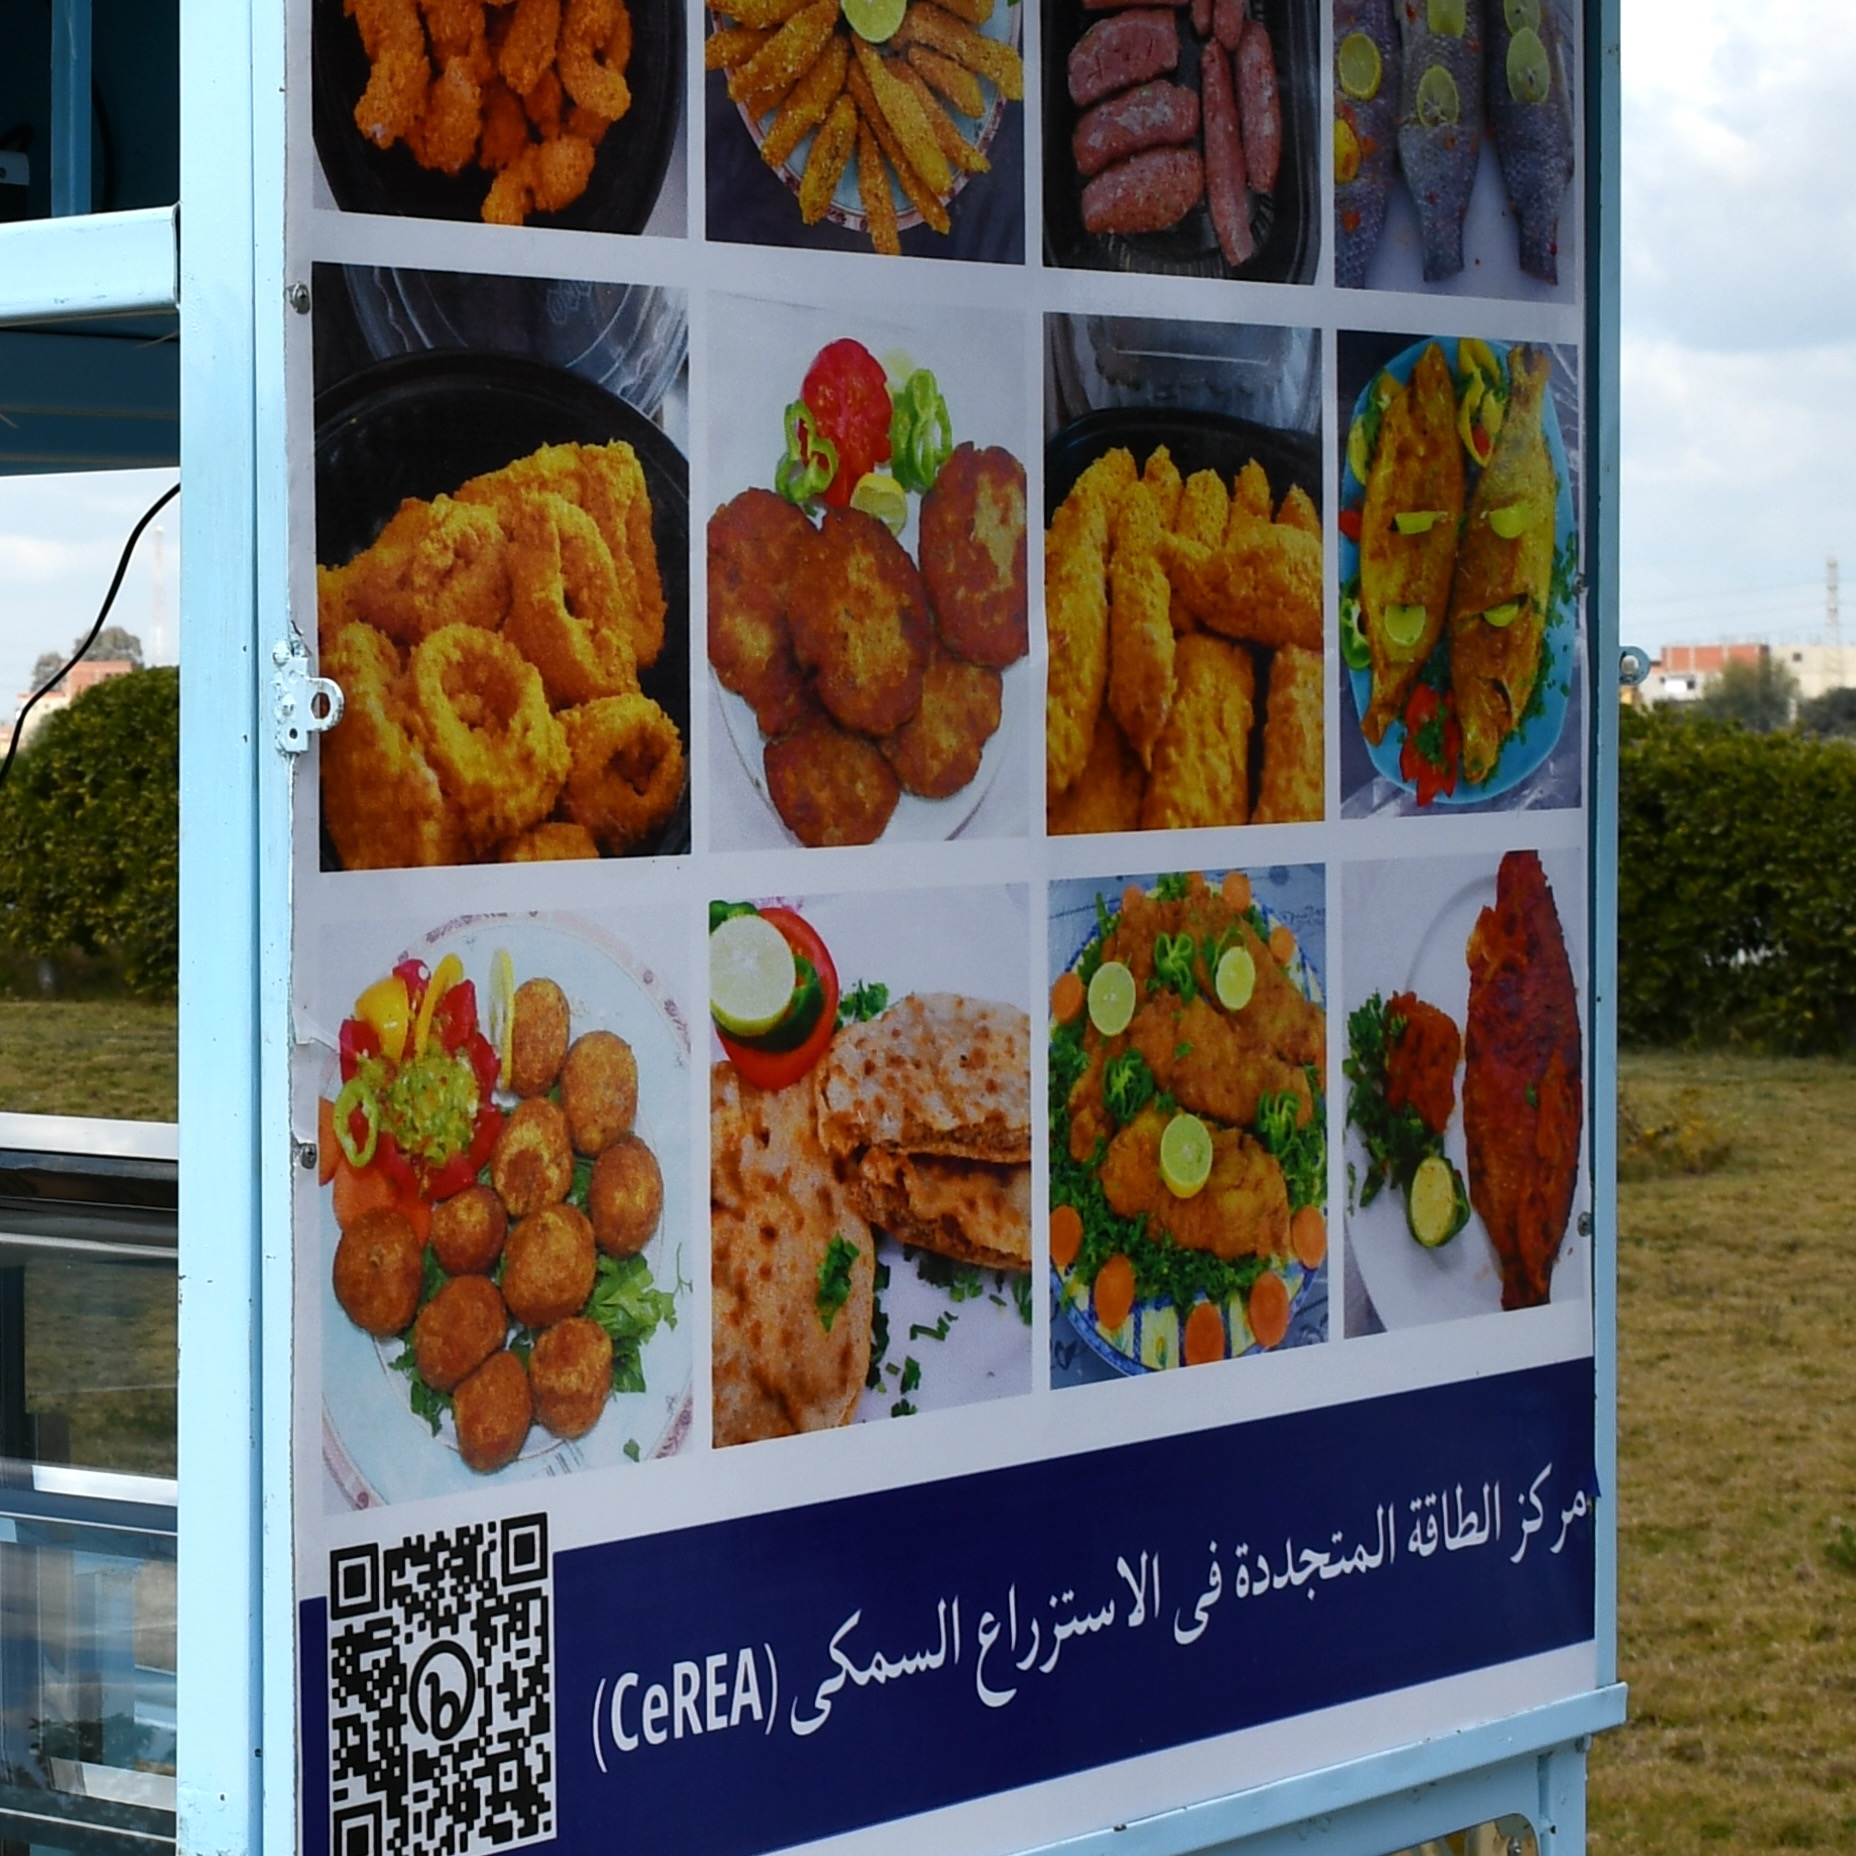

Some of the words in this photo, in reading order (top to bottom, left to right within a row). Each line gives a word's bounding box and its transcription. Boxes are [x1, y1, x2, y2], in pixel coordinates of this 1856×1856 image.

[1234, 1501, 1396, 1601] المتجددة
[1407, 1479, 1503, 1557] الطاقة
[1510, 1462, 1588, 1564] مركز
[975, 1551, 1161, 1708] الاستزراع
[591, 1642, 778, 1774] (CeREA)
